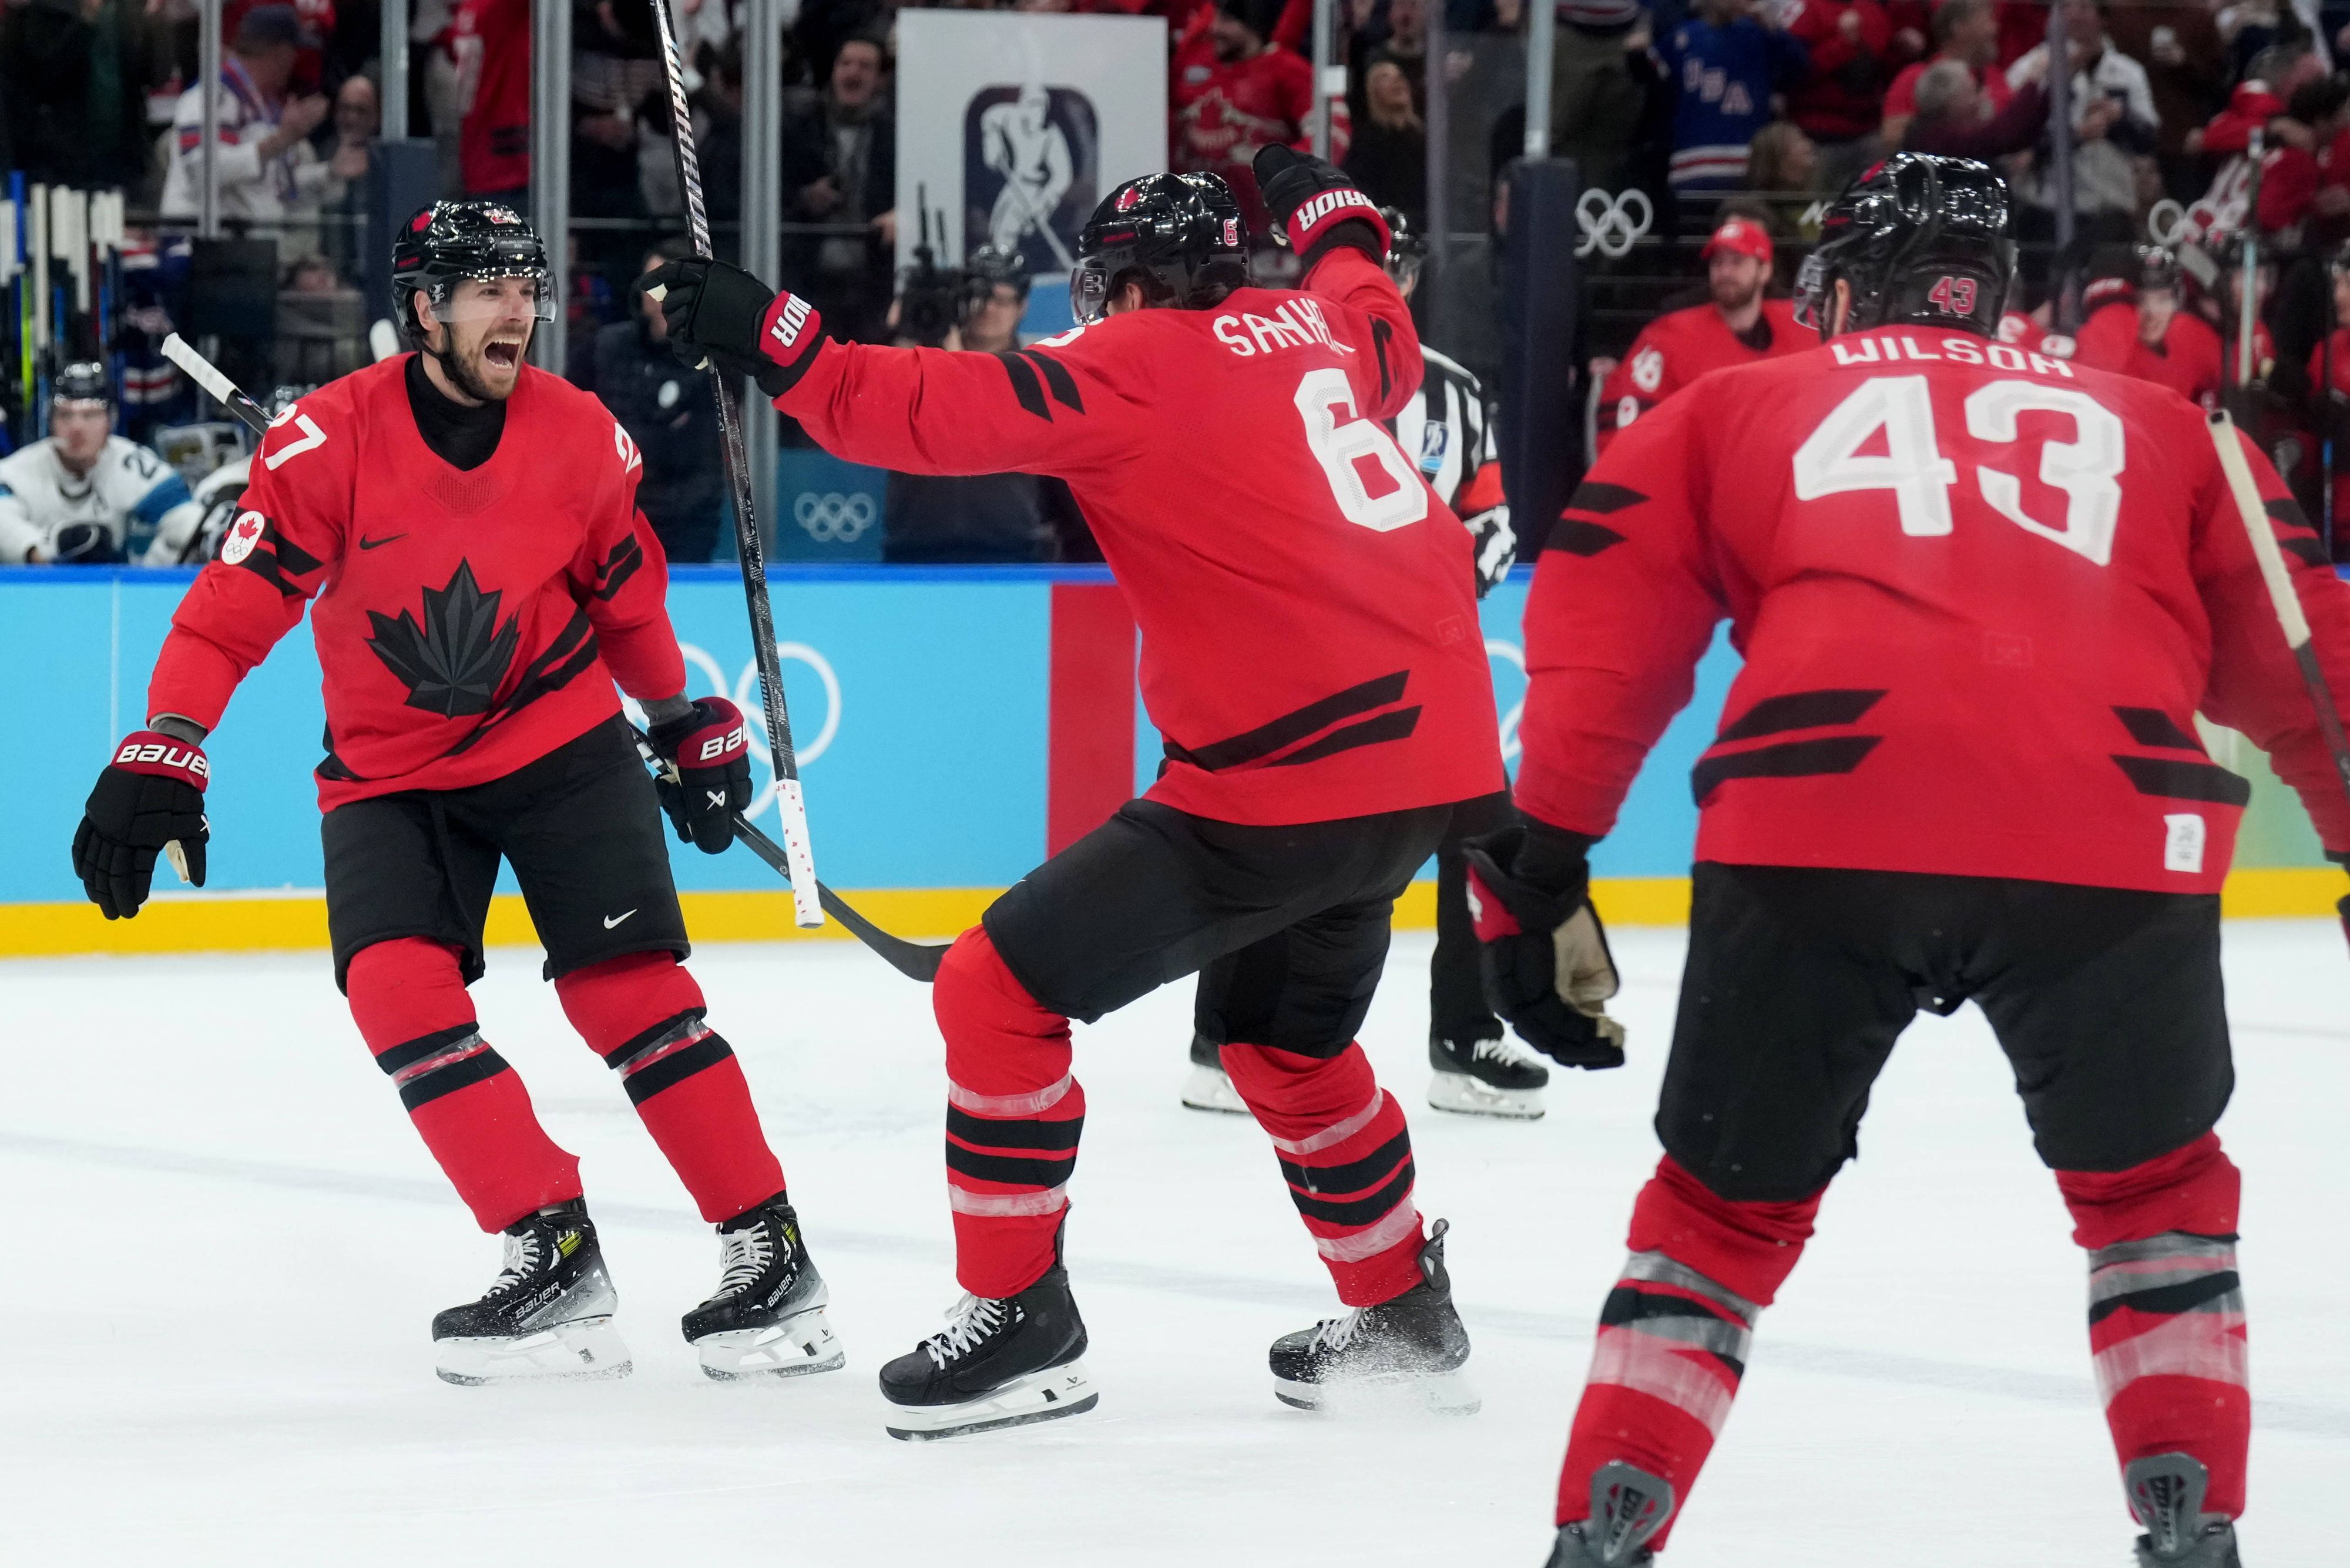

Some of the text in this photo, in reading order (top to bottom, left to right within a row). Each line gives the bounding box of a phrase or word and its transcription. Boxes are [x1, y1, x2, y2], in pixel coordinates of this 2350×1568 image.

[1223, 219, 1238, 246] 6
[1928, 276, 1978, 314] 43
[1831, 337, 2074, 377] WILSON
[1294, 368, 1428, 532] 6
[1792, 374, 2126, 566] 43
